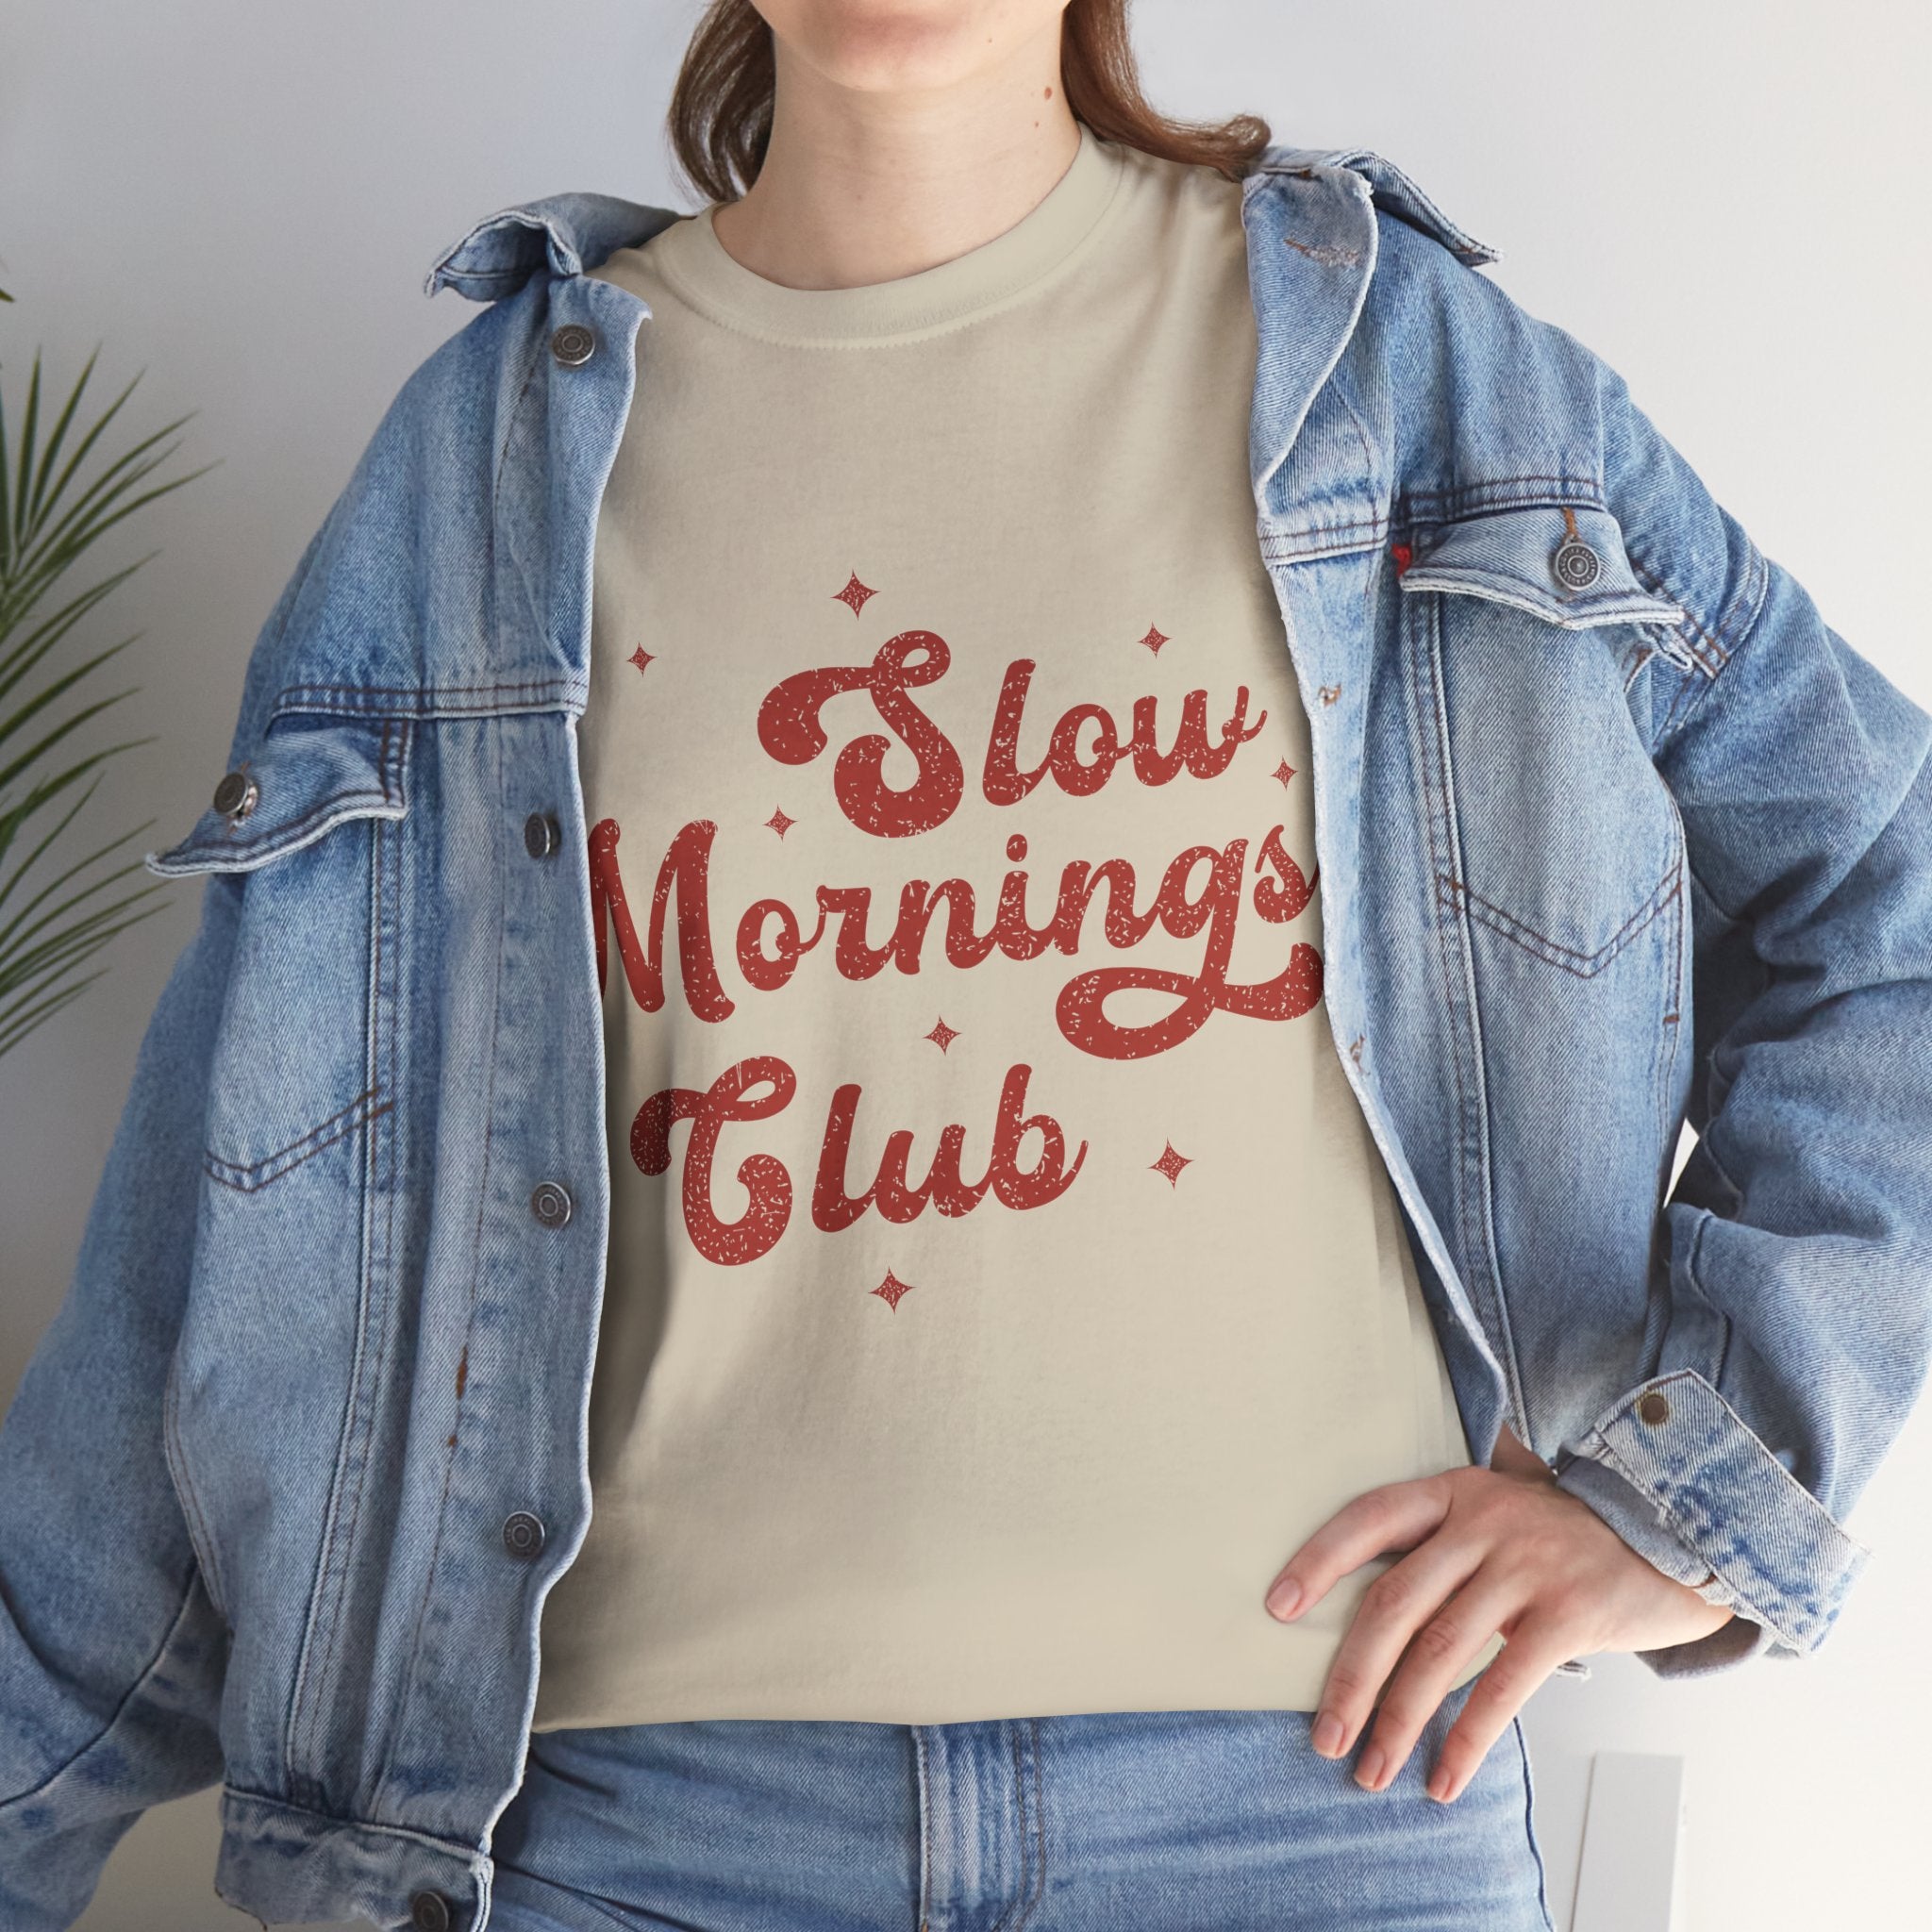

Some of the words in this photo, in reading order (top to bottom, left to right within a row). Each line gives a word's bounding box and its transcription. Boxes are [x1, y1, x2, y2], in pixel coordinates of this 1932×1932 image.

[758, 630, 1268, 839] Slow
[587, 818, 1324, 1060] Mornings
[630, 1056, 1089, 1267] Club
